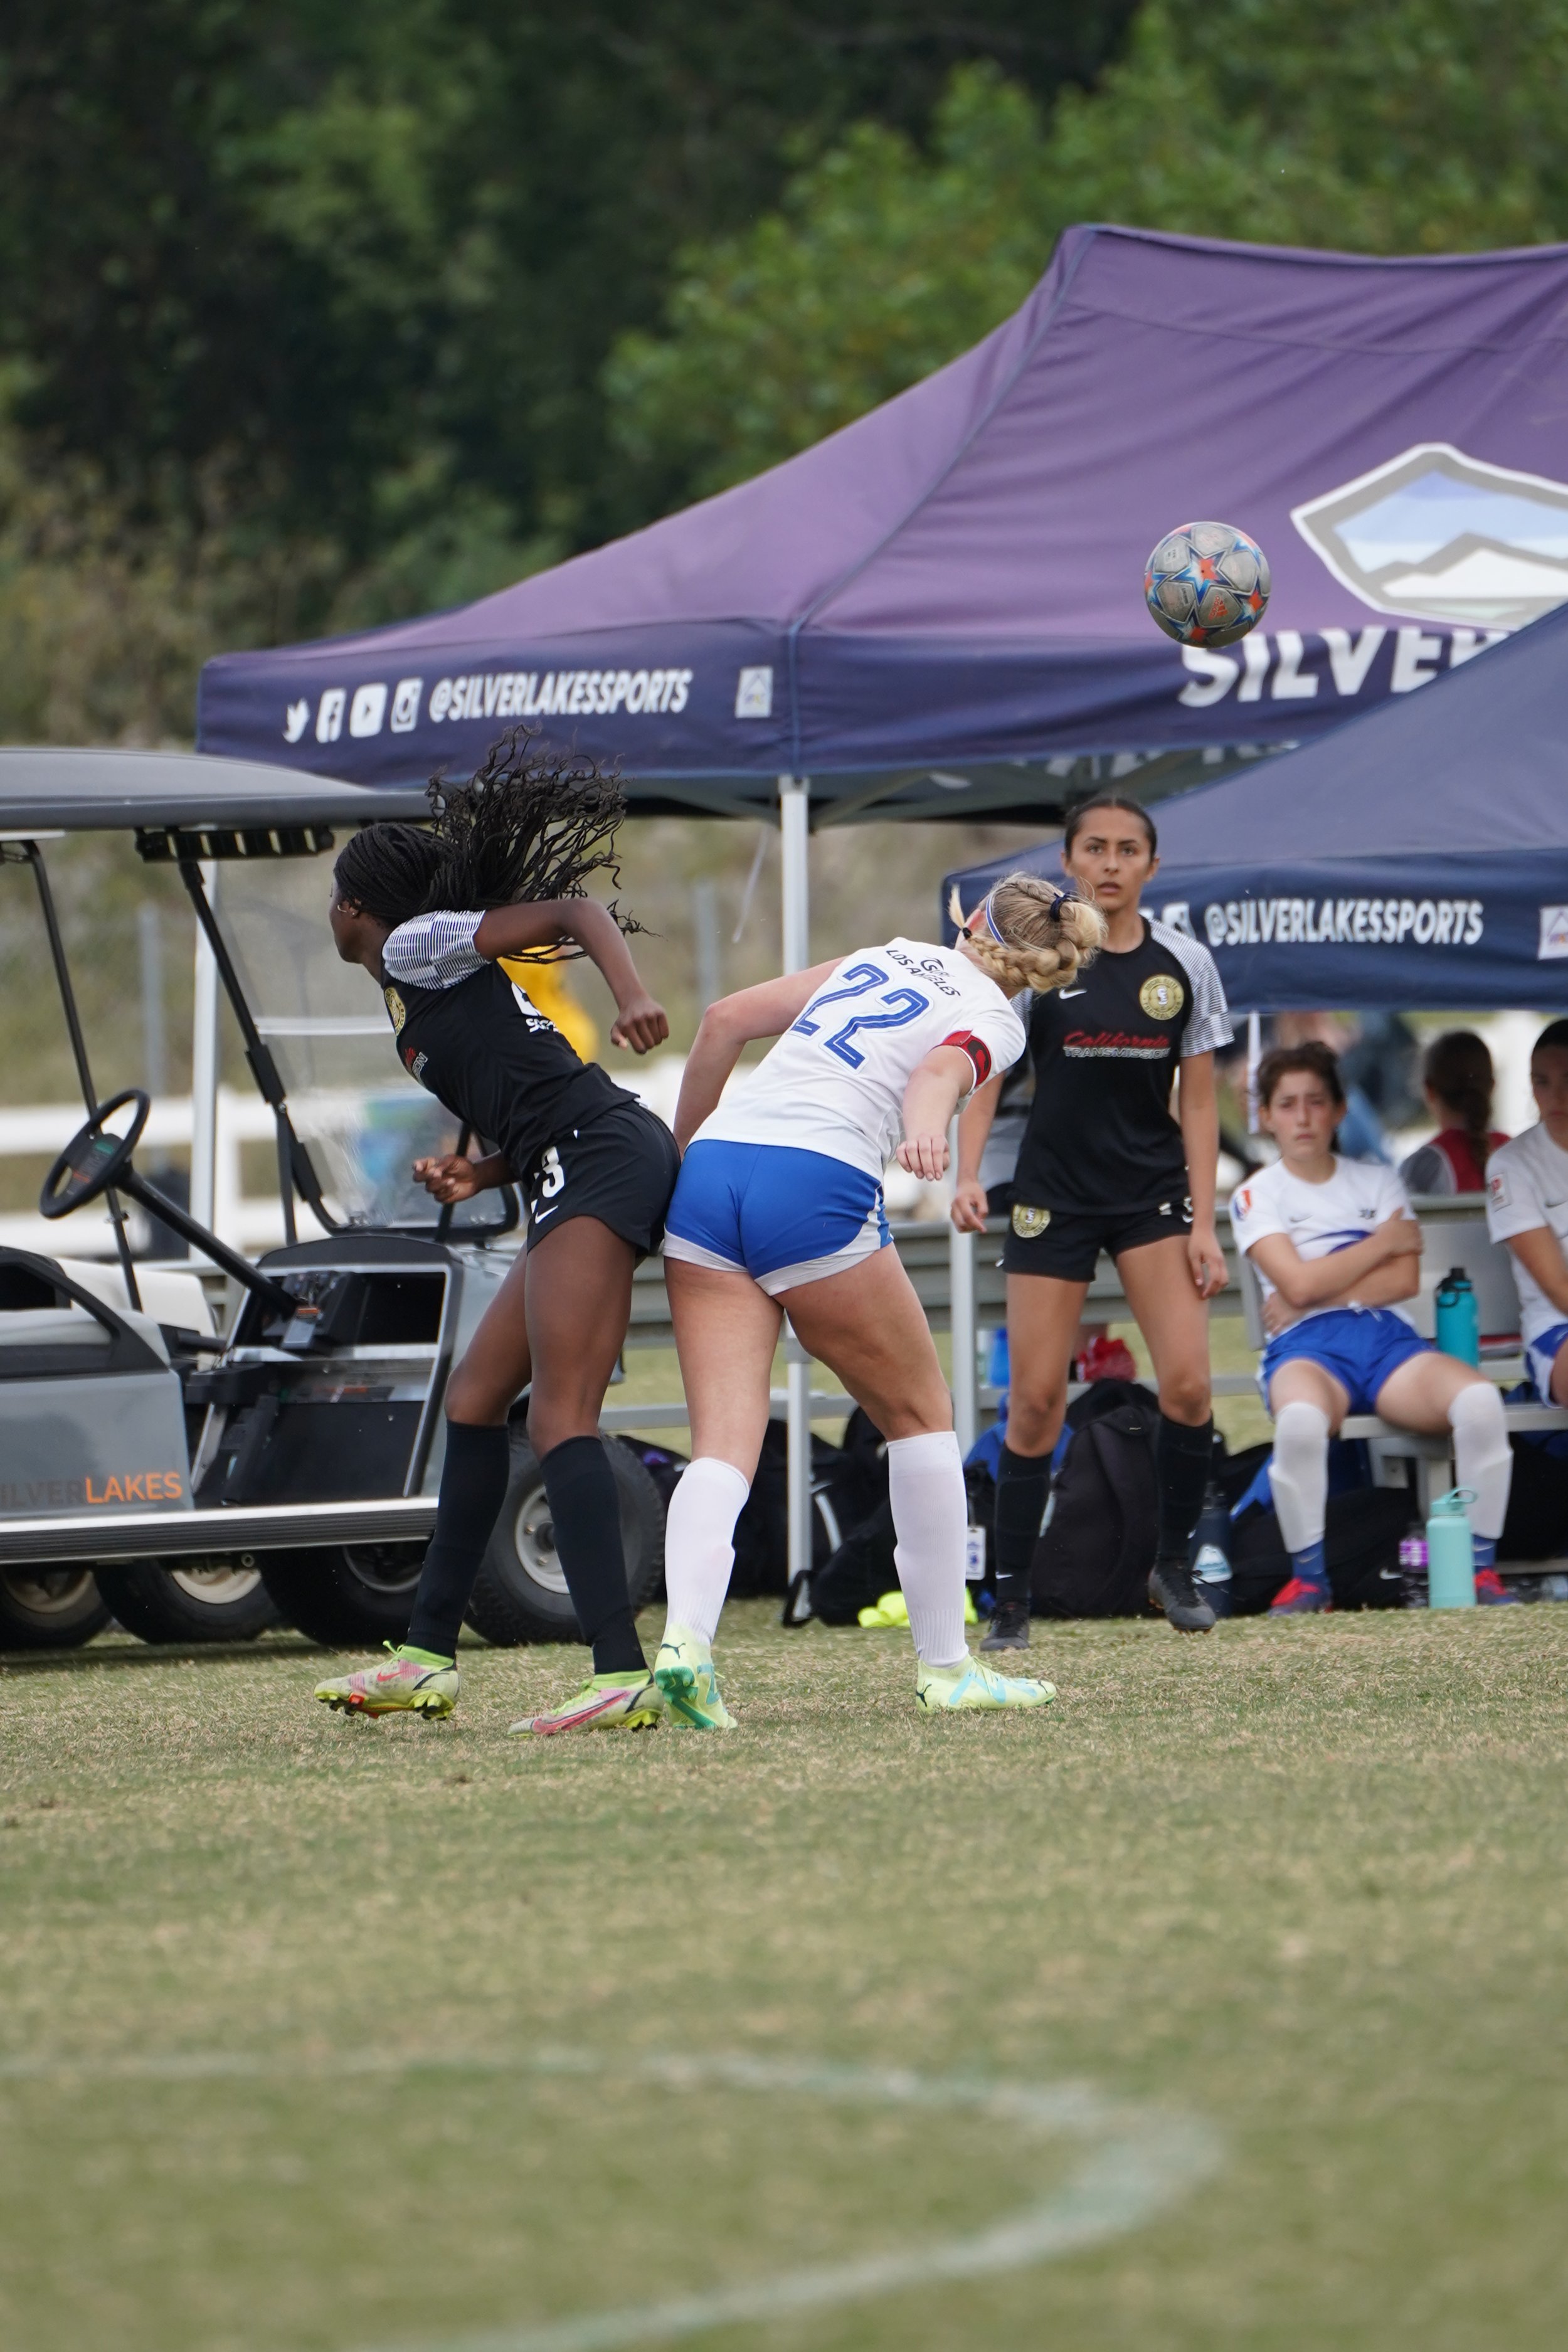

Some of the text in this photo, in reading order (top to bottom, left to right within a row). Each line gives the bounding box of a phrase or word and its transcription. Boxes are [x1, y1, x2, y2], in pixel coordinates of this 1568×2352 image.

[429, 670, 693, 723] @SILVERLAKESSPORTS
[1204, 898, 1484, 946] @SILVERLAKESSPORTS
[886, 950, 961, 996] LOS ANGELES
[790, 963, 930, 1069] 22
[0, 1471, 183, 1507] ILVERLAKES
